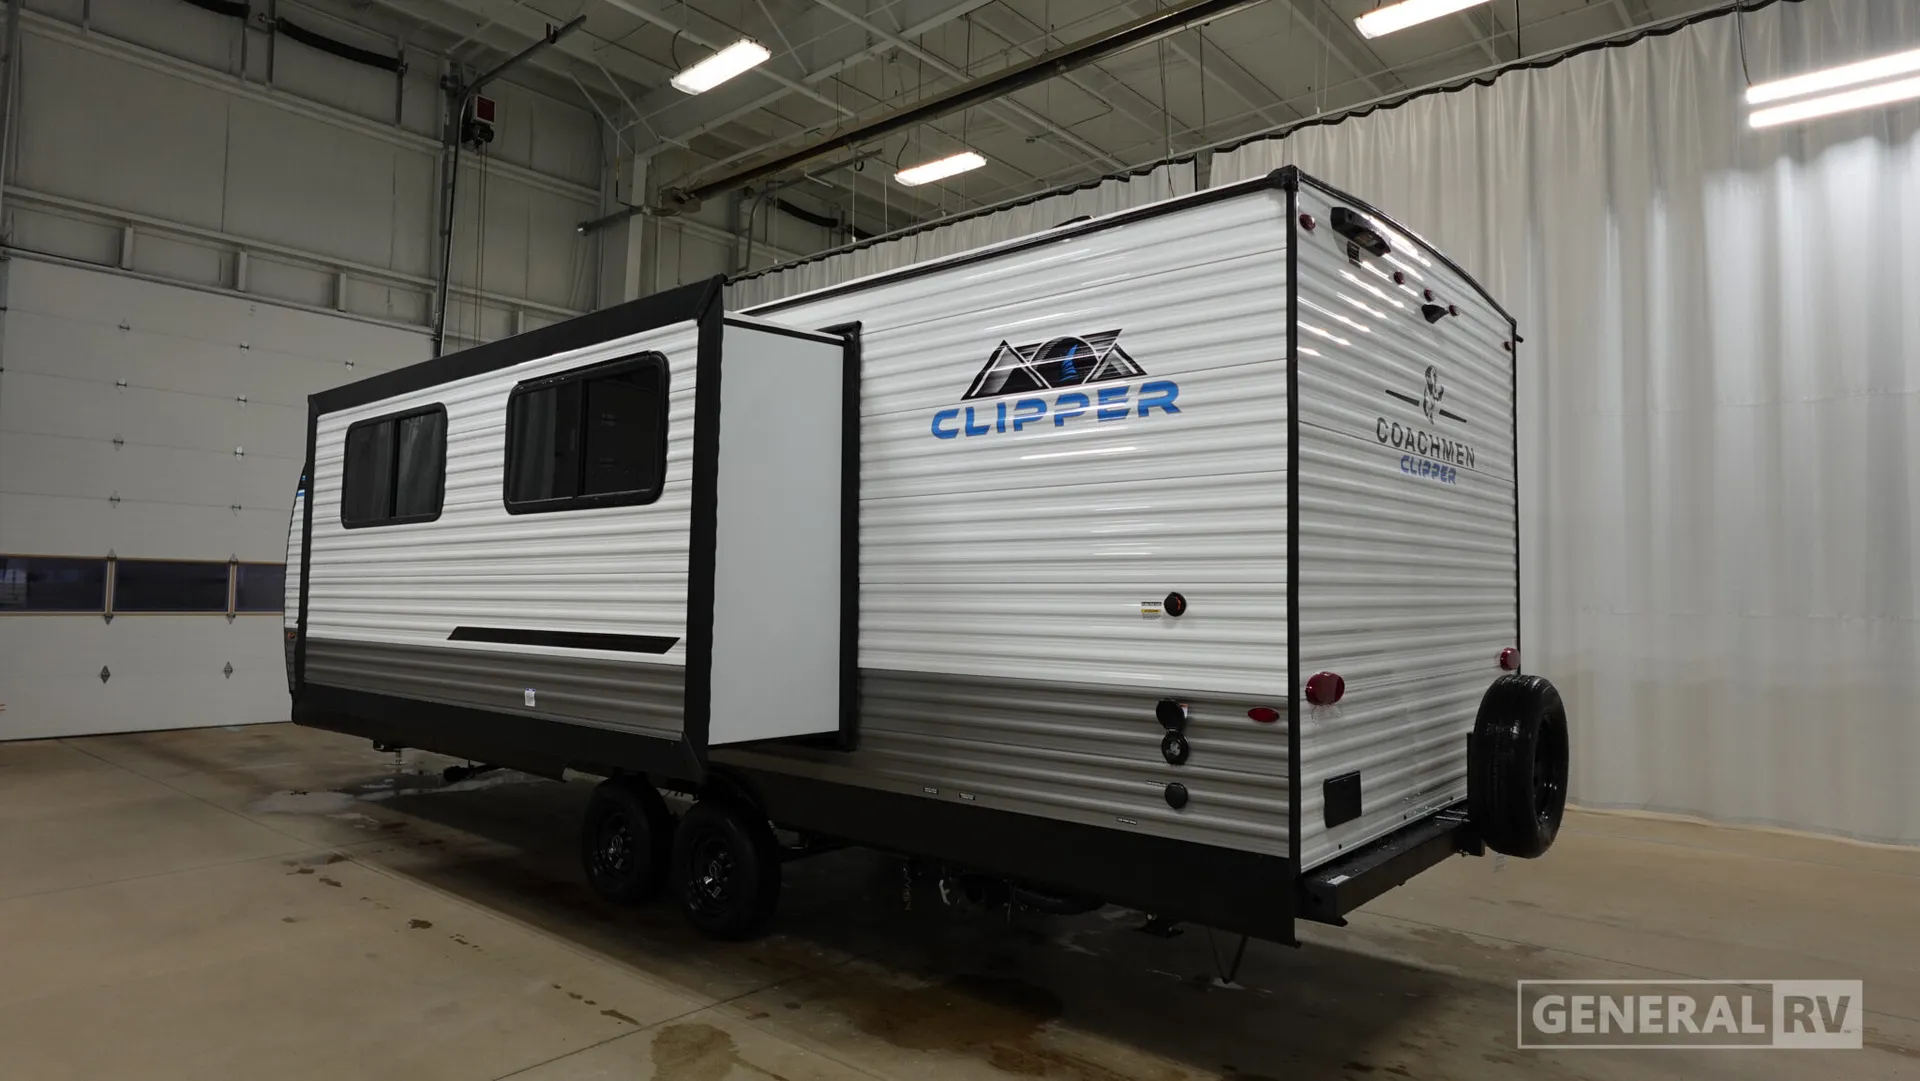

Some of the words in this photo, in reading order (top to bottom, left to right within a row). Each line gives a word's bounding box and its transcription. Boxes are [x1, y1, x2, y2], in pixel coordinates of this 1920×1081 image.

[931, 380, 1182, 439] CLIPPER
[1376, 417, 1475, 468] COACHMEN
[1400, 455, 1457, 485] CLIPPER
